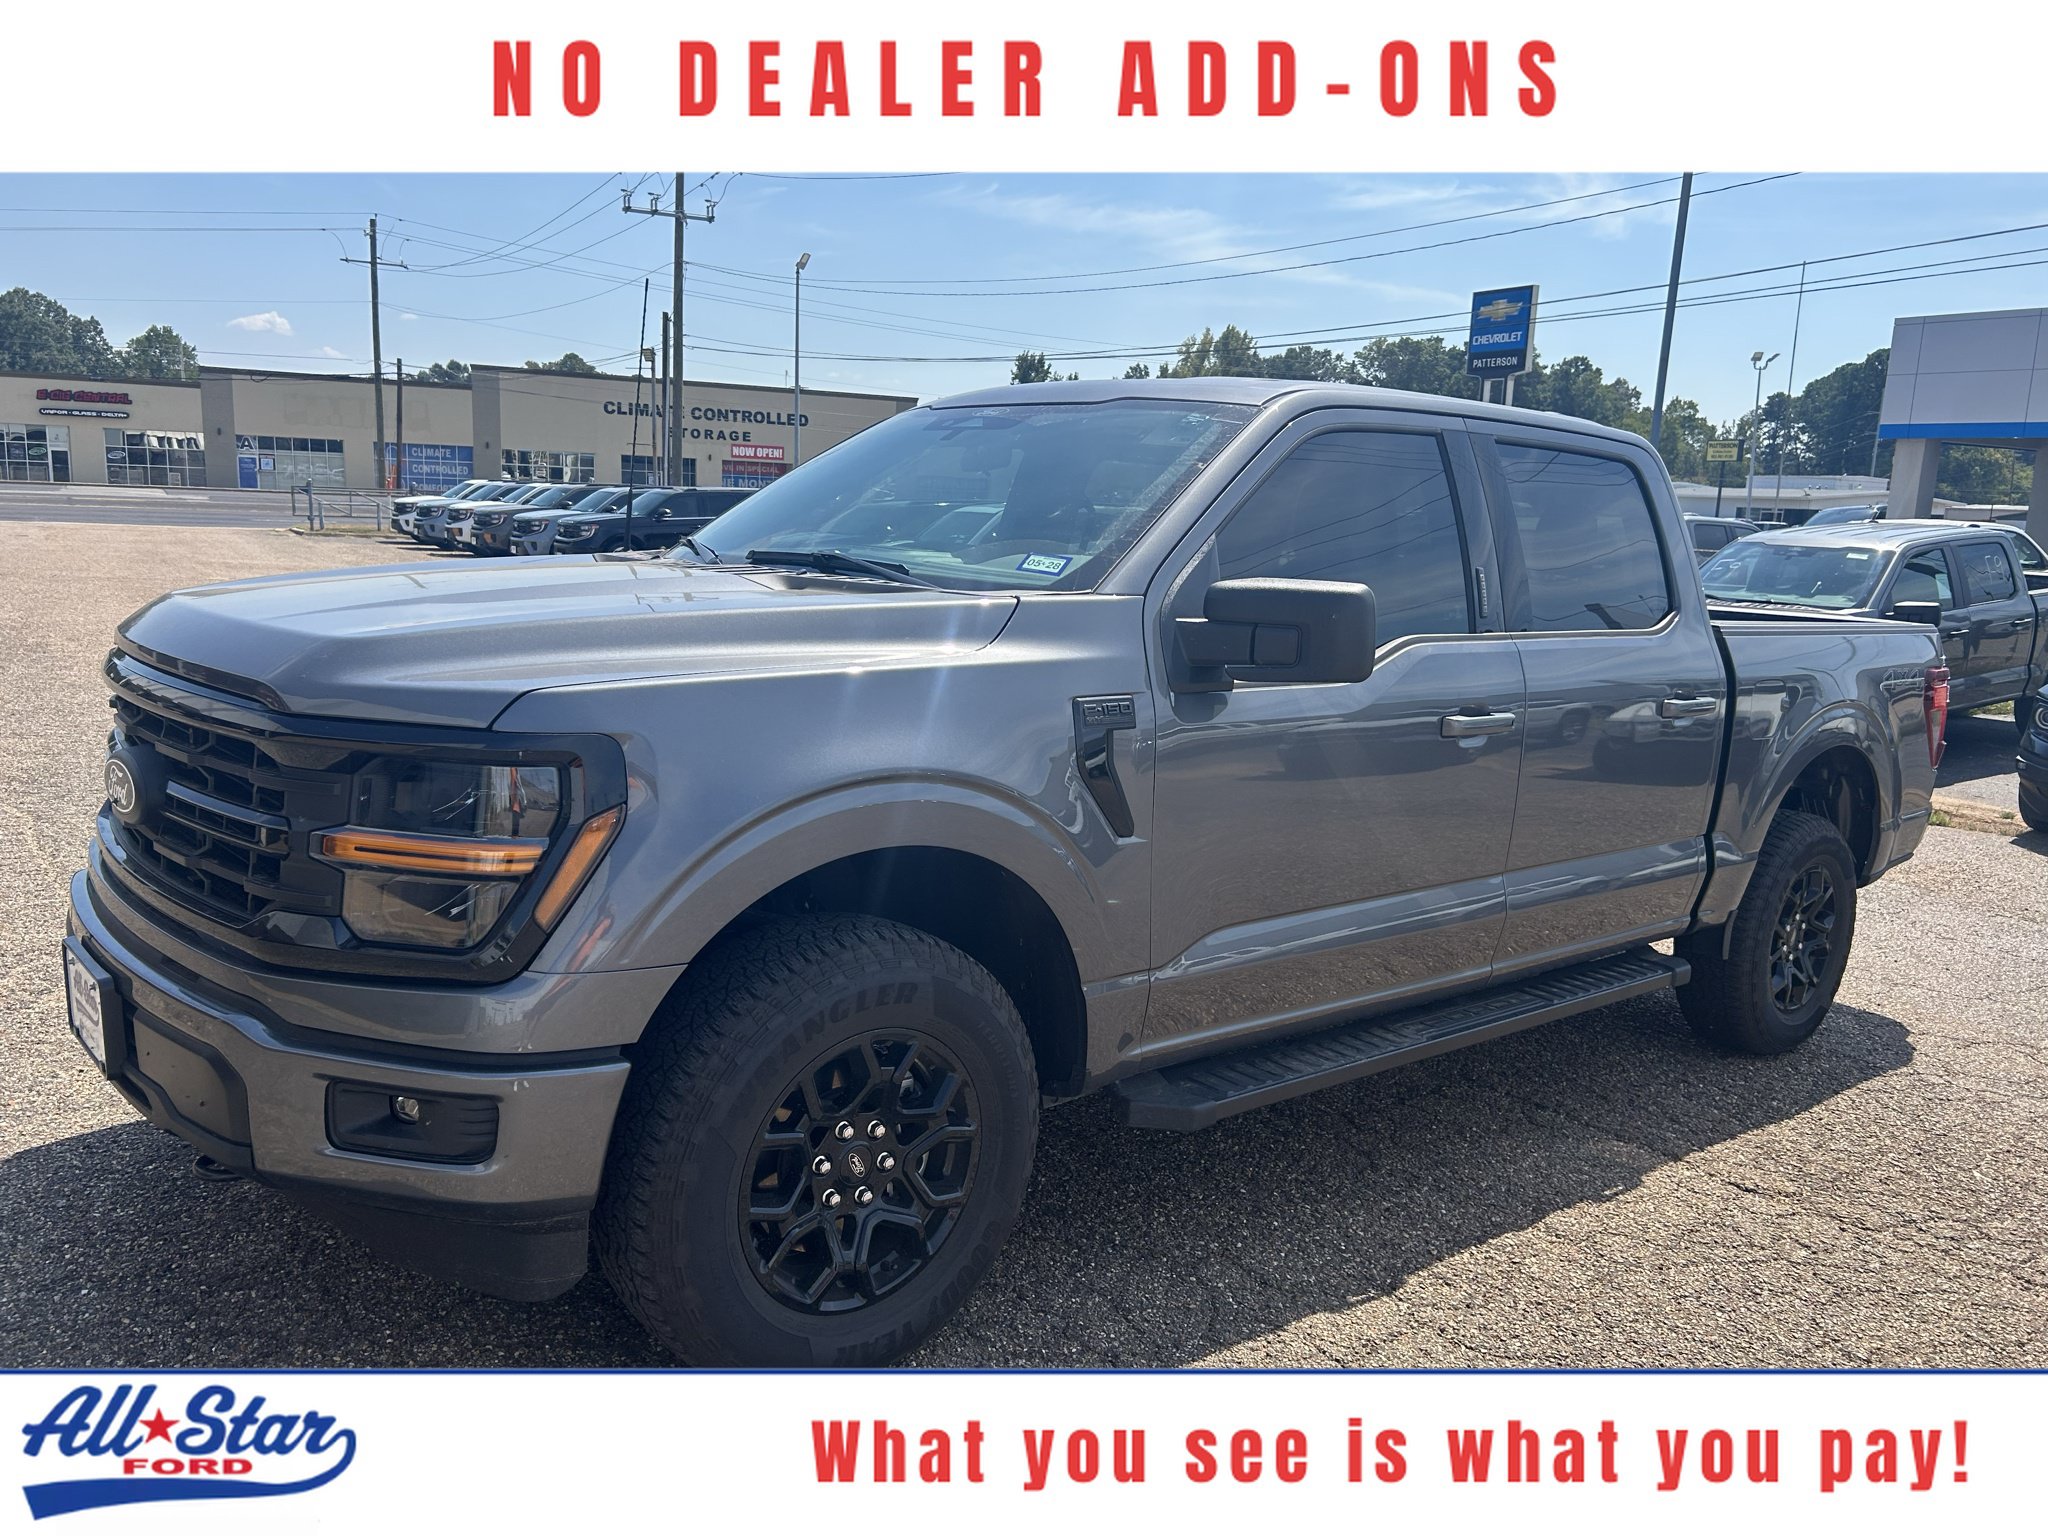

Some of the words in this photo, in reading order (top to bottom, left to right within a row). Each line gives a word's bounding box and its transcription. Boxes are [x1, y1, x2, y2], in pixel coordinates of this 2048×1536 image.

[1472, 331, 1522, 345] CHEVROLET
[1472, 356, 1518, 368] PATTERSON
[73, 391, 132, 404] CENTRAL
[603, 401, 685, 419] CLIMA
[691, 406, 809, 428] CONTROLLED
[240, 437, 255, 451] A
[411, 447, 452, 458] CLIMATE
[732, 446, 756, 457] NOW
[756, 448, 783, 458] OPEN!
[412, 464, 469, 475] CONTROLLED
[746, 465, 780, 473] SPECIAL
[108, 764, 128, 806] Ford
